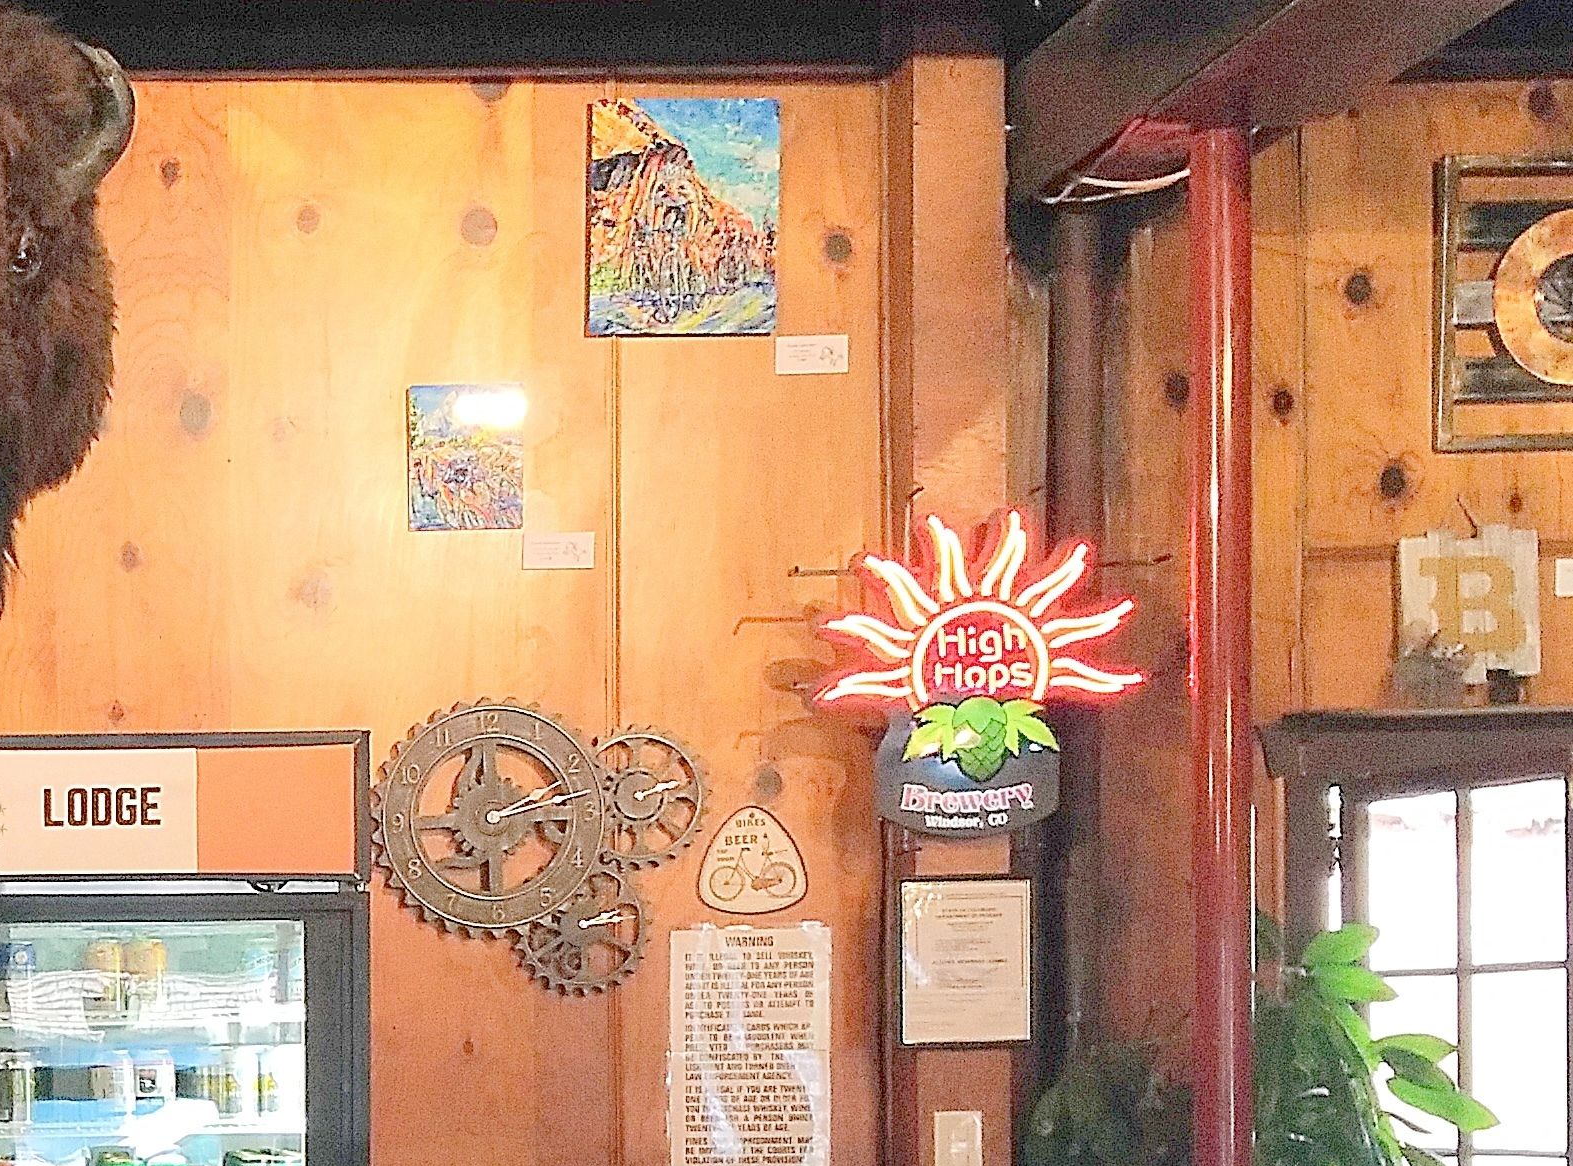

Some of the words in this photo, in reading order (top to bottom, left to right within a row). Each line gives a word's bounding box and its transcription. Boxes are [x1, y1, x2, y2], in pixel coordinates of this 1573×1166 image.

[936, 623, 1027, 662] High
[934, 661, 1033, 694] Hops
[478, 713, 499, 732] 12
[432, 729, 450, 746] 11
[568, 754, 582, 773] 2
[401, 765, 420, 784] 10
[900, 782, 1034, 813] Brewery
[42, 787, 163, 828] LODGE
[584, 802, 597, 821] 3
[392, 815, 404, 833] 9
[735, 818, 766, 828] BIKES
[925, 815, 983, 829] Windsor,
[725, 834, 758, 846] BEER
[572, 851, 583, 868] 4
[407, 860, 422, 878] 8
[447, 895, 458, 913] 7
[539, 888, 553, 906] 5
[493, 903, 505, 920] 6
[725, 935, 774, 947] WARNING
